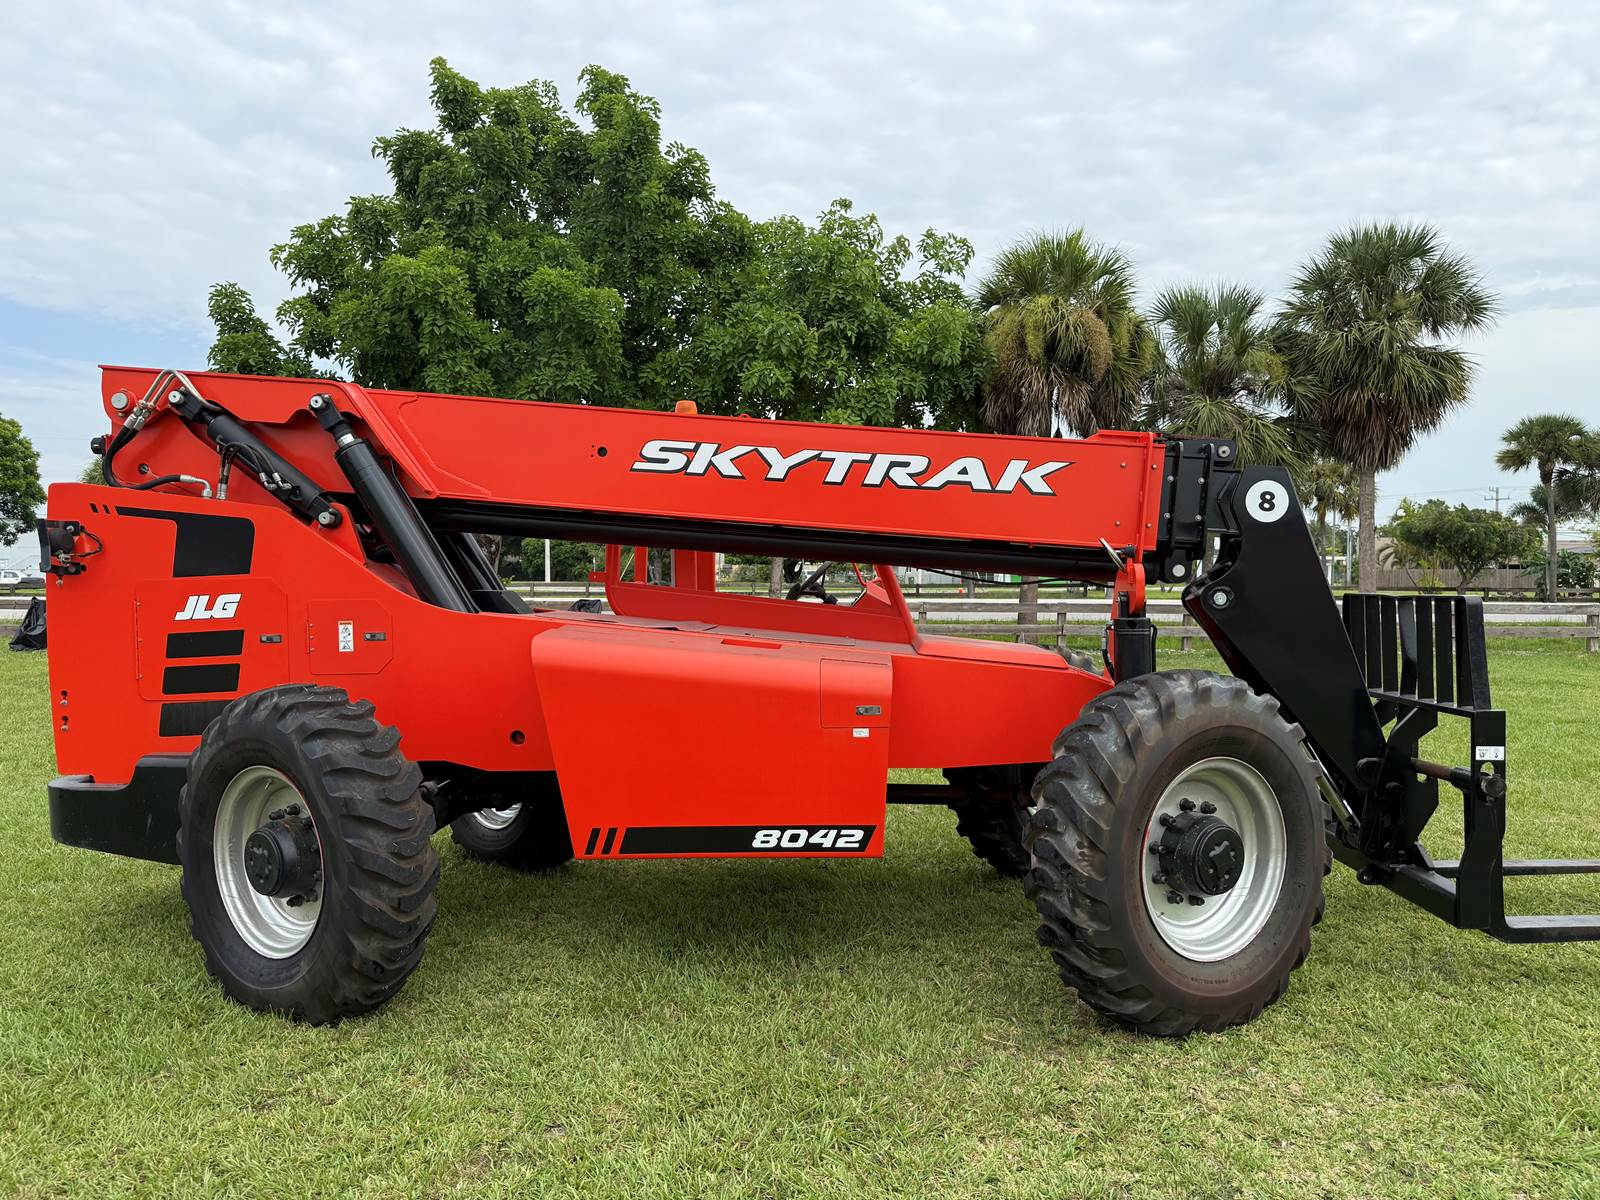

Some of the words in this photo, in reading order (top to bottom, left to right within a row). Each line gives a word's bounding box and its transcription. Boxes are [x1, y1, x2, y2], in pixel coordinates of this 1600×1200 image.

[630, 440, 1075, 496] SKYTRAK
[1259, 491, 1275, 511] 8
[174, 594, 242, 620] JLG
[752, 829, 865, 848] 8042
